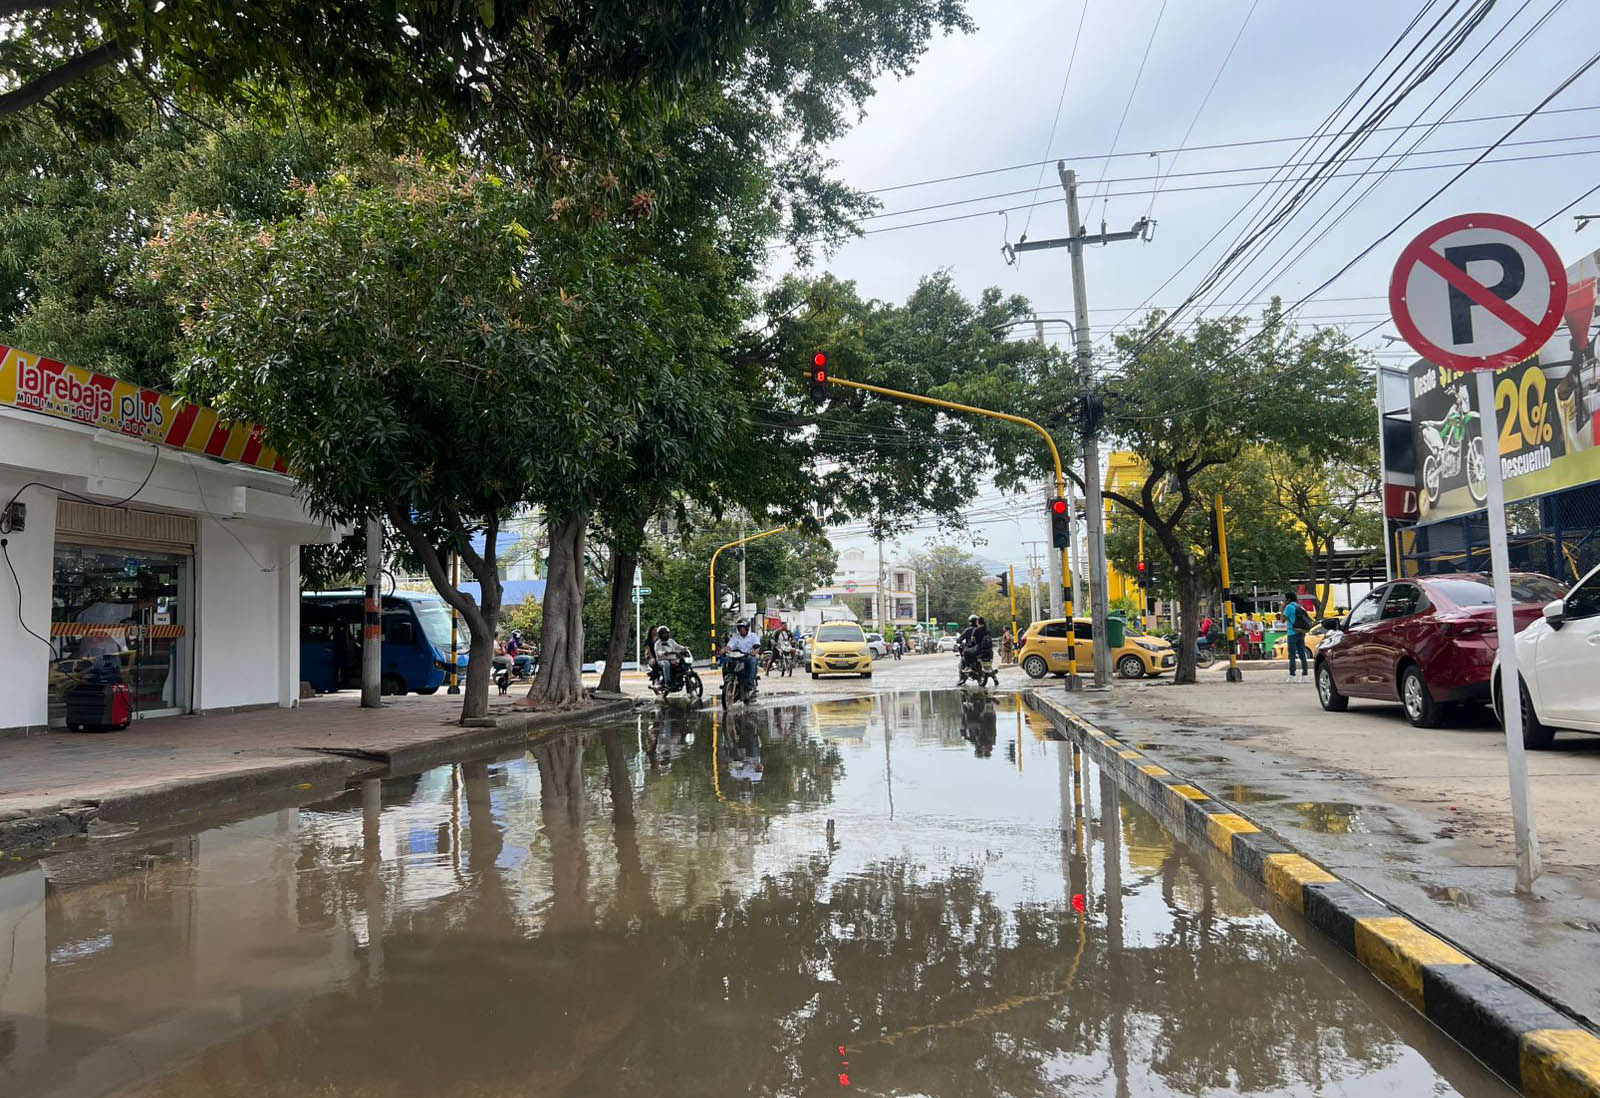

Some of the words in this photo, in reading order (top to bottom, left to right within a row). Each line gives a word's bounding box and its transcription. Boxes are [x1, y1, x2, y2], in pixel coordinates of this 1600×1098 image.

[1444, 242, 1526, 345] P
[16, 392, 91, 420] MINIMARKET
[121, 392, 163, 426] plus
[1495, 366, 1553, 456] 20%
[1501, 444, 1552, 480] Descuento
